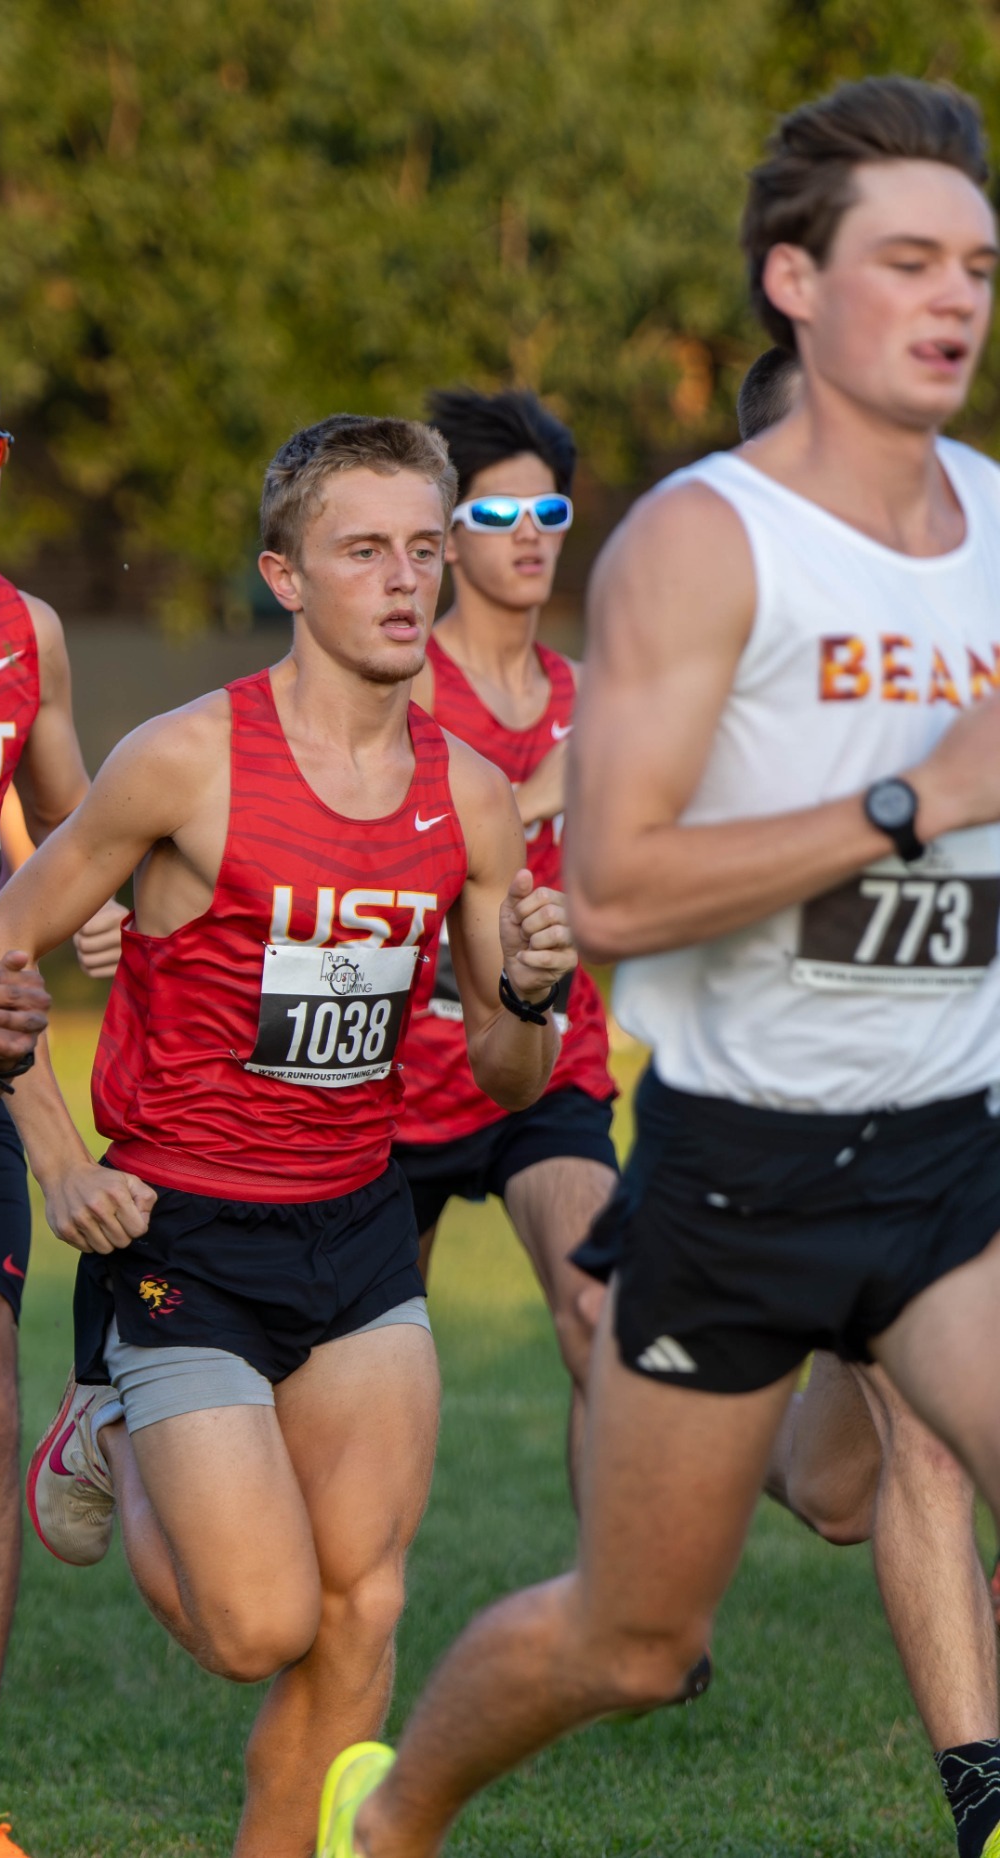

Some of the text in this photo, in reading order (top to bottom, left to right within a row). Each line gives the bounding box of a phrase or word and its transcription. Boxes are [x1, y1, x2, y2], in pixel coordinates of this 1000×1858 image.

[269, 885, 438, 949] UST
[854, 878, 973, 966] 773
[286, 999, 391, 1064] 1038
